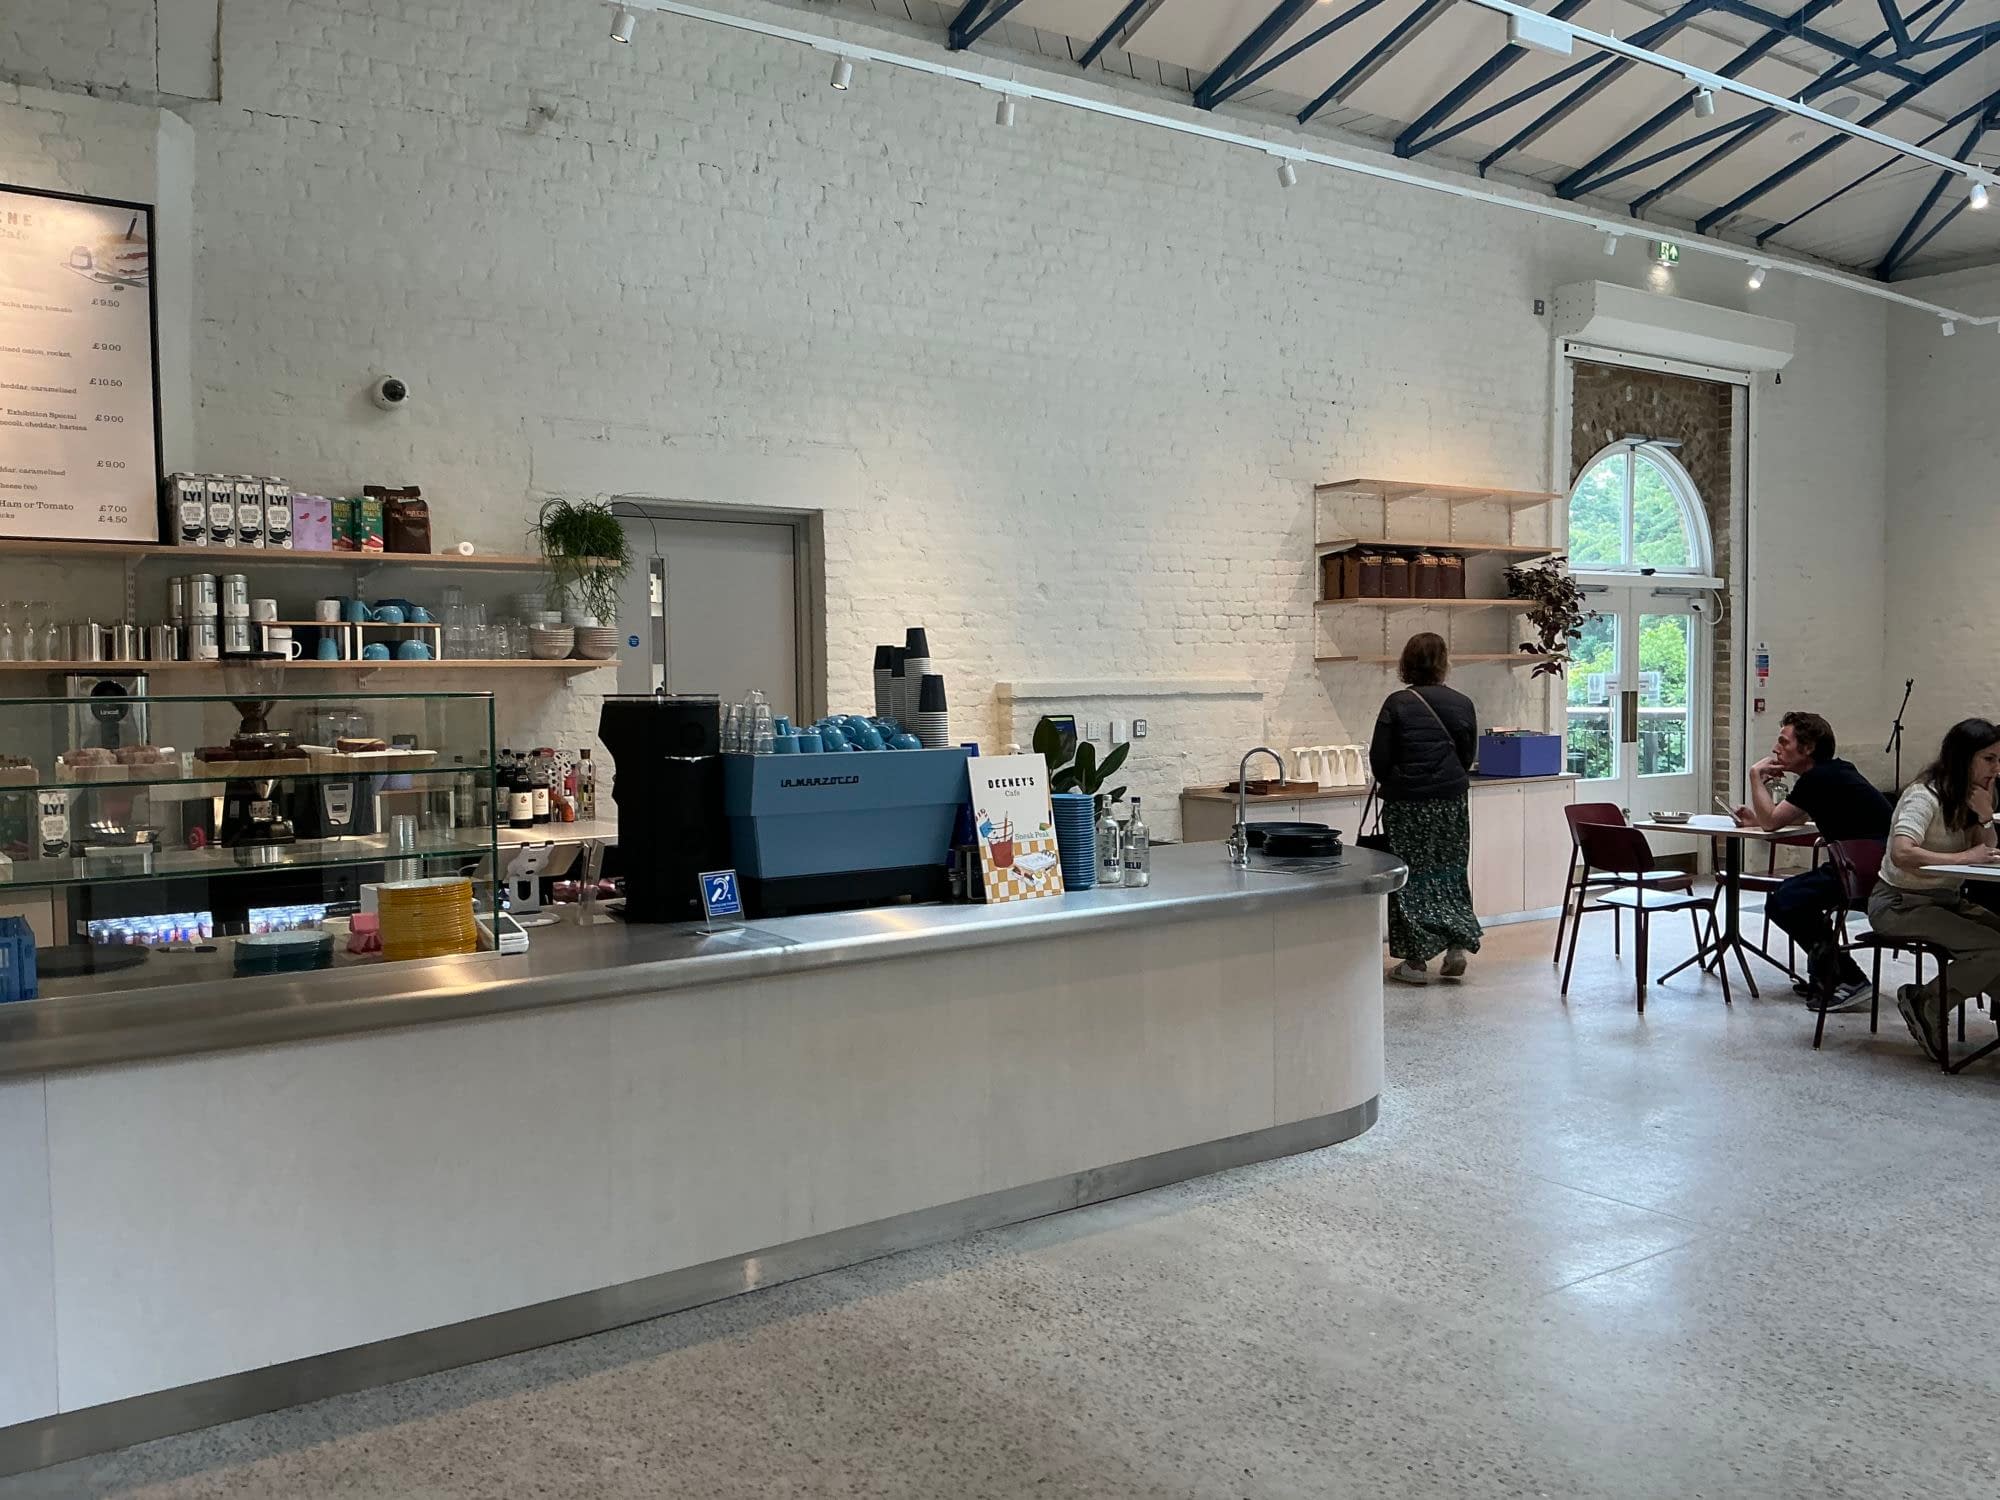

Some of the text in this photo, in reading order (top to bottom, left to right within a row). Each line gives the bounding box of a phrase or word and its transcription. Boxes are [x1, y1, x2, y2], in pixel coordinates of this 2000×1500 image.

[31, 386, 77, 394] caramelised
[7, 408, 77, 420] Exhibition Special
[19, 468, 66, 476] caramelised
[0, 500, 22, 509] Ham
[36, 501, 74, 511] Tomato
[987, 776, 1035, 789] DEENEY'S
[1004, 789, 1021, 797] Cafe
[1103, 859, 1120, 867] BELU
[1124, 861, 1142, 869] BELU
